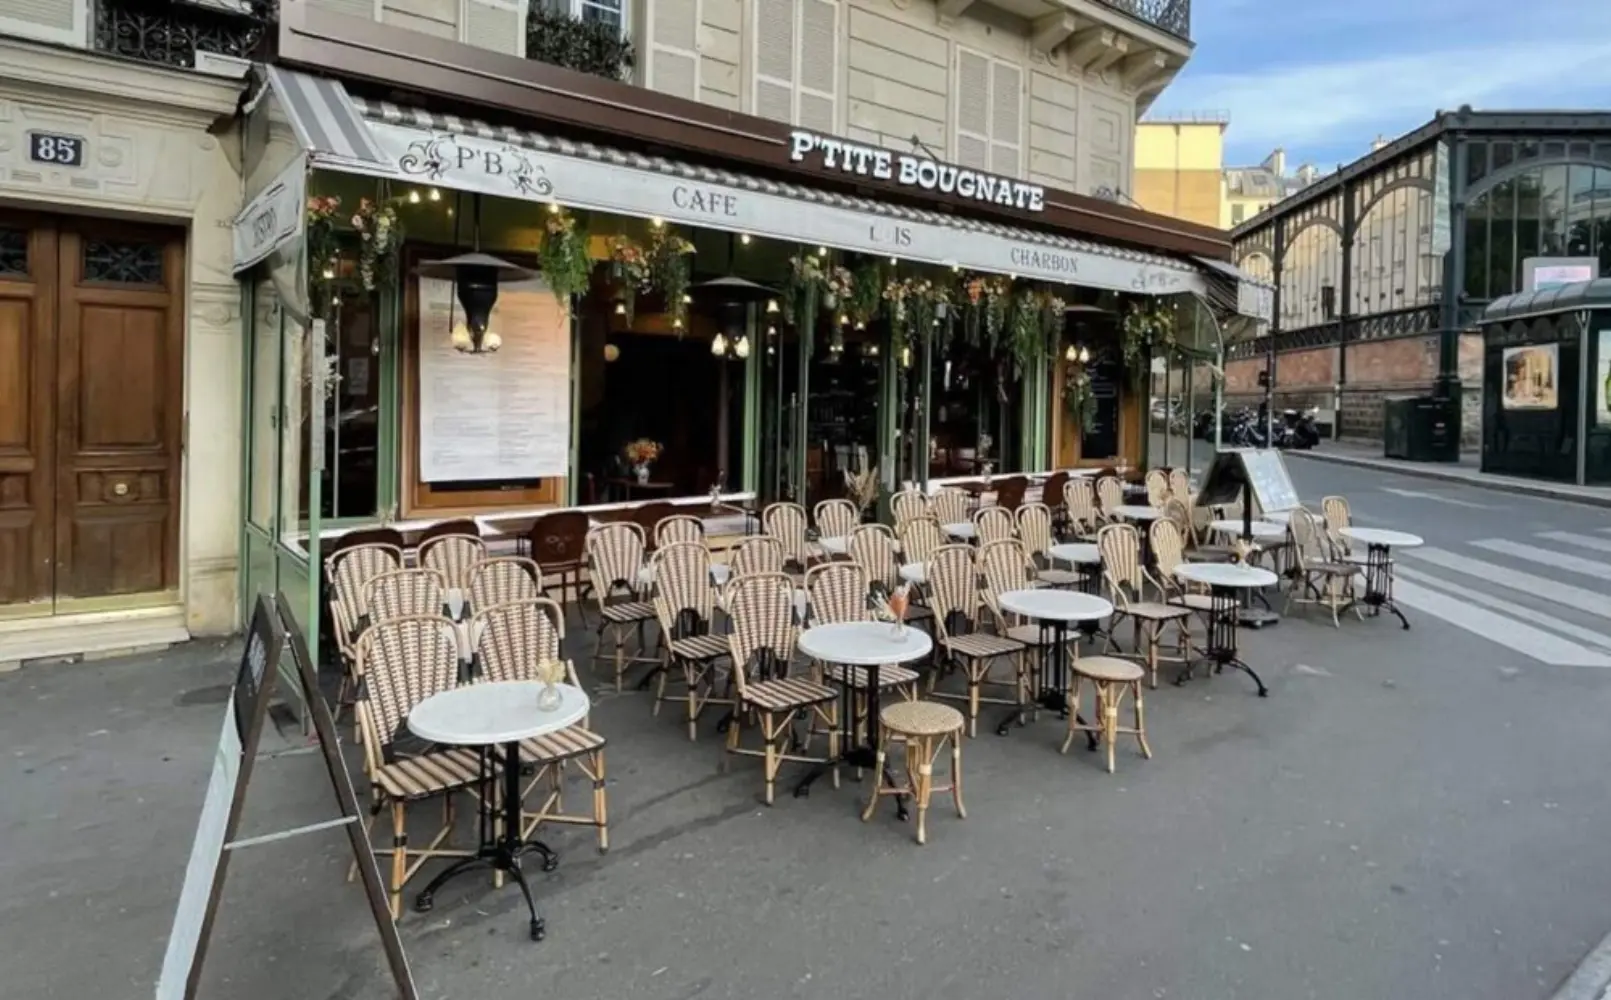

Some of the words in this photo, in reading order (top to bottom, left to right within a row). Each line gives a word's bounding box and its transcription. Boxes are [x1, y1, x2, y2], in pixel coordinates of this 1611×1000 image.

[37, 136, 76, 163] 85
[456, 146, 503, 175] P'B
[790, 131, 893, 180] P'TITE
[898, 156, 1045, 212] BOUGNATE
[671, 186, 738, 217] CAFE
